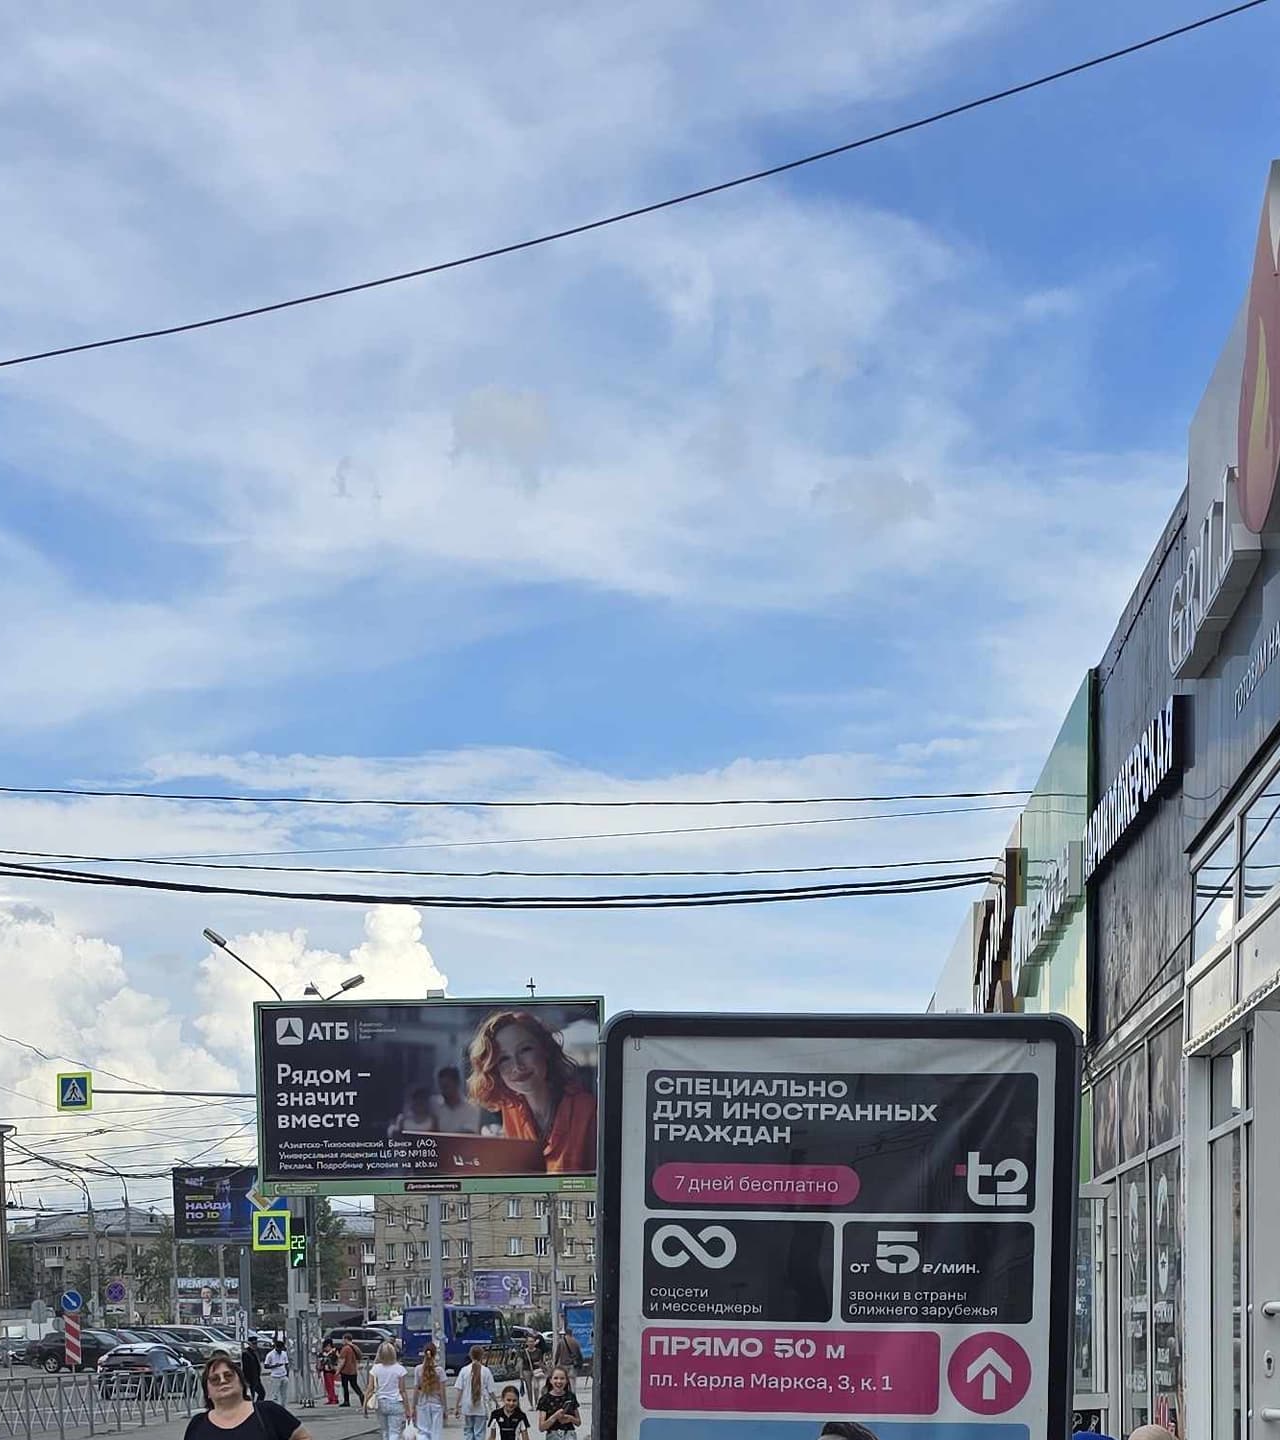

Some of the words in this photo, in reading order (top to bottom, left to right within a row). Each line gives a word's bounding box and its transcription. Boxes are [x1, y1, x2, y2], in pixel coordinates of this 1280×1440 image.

[1169, 465, 1240, 676] GRILL
[1234, 640, 1267, 720] ГОТОВИМ
[1269, 621, 1280, 664] НА
[1083, 694, 1174, 885] ПАРИКМАХЕРСКАЯ
[307, 1022, 349, 1041] АТБ
[277, 1063, 351, 1086] Рядом
[654, 1077, 848, 1100] СПЕЦИАЛЬНО
[276, 1091, 357, 1106] значит
[277, 1112, 360, 1129] вместе
[653, 1101, 712, 1121] ДЛЯ
[722, 1103, 938, 1122] ИНОСТРАННЫХ
[653, 1124, 791, 1145] ГРАЖДАН
[380, 1150, 393, 1159] ЦБ
[394, 1150, 407, 1158] РФ
[317, 1162, 364, 1171] Подробные
[366, 1162, 399, 1170] условия
[674, 1176, 685, 1191] 7
[687, 1177, 736, 1194] дней
[739, 1175, 839, 1194] бесплатно
[185, 1201, 231, 1209] НАЙДИ
[291, 1235, 305, 1249] 22
[875, 1230, 920, 1274] 5
[650, 1286, 708, 1300] соцсети
[849, 1290, 899, 1301] звонки
[903, 1291, 912, 1301] в
[914, 1291, 967, 1304] страны
[650, 1302, 657, 1313] и
[662, 1302, 762, 1316] мессенджеры
[849, 1302, 917, 1316] ближнего
[921, 1303, 998, 1318] зарубежья
[650, 1336, 763, 1359] ПРЯМО
[773, 1338, 816, 1360] 50
[649, 1374, 678, 1388] пл.
[683, 1373, 745, 1391] Карла
[750, 1374, 833, 1393] Маркса,
[838, 1376, 855, 1393] 3,
[860, 1379, 878, 1392] к.
[881, 1376, 893, 1391] 1
